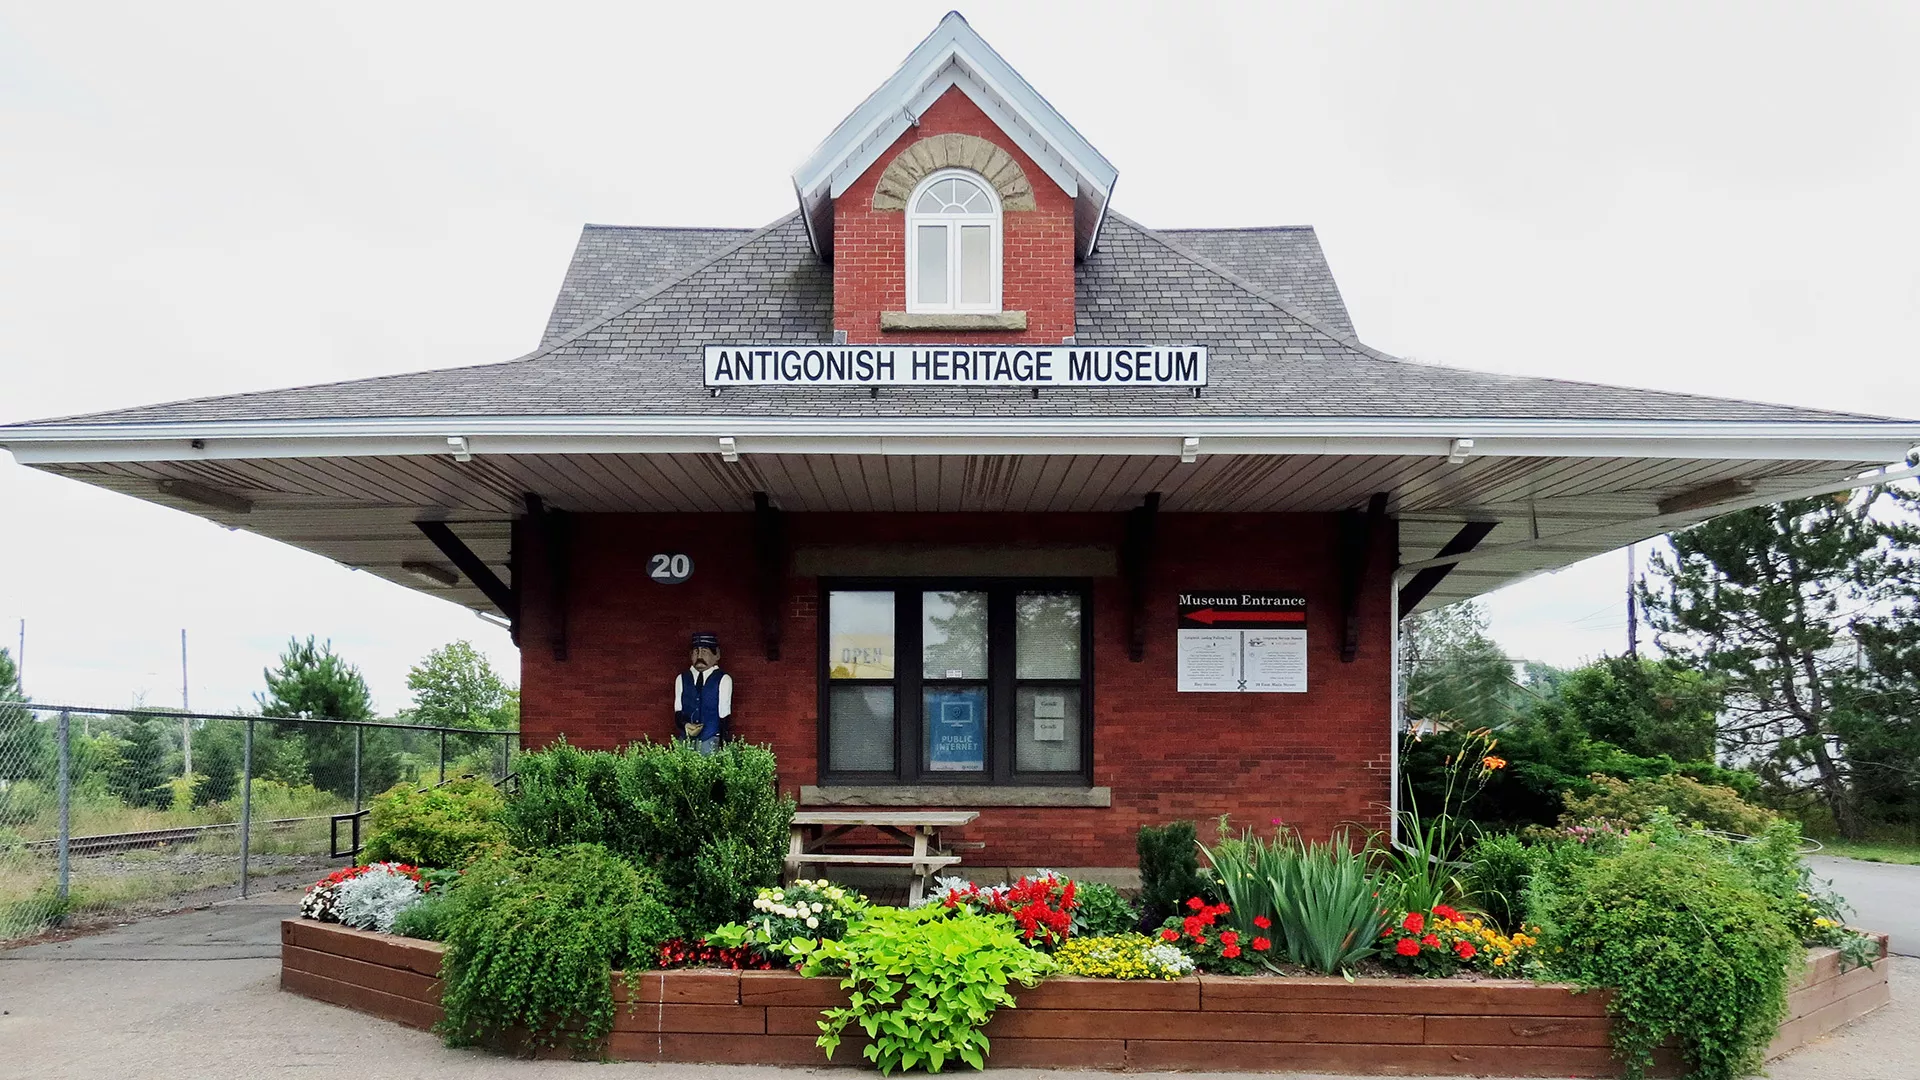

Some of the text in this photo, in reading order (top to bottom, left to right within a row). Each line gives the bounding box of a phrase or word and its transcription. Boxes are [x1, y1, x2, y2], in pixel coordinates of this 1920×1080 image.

[714, 350, 1199, 381] ANTIGONISH HERITAGE MUSEUM
[651, 554, 690, 577] 20
[1179, 594, 1306, 606] Museum Entrance
[841, 647, 883, 664] OPEN
[941, 735, 973, 743] PUBLIC
[936, 743, 978, 751] INTERNET
